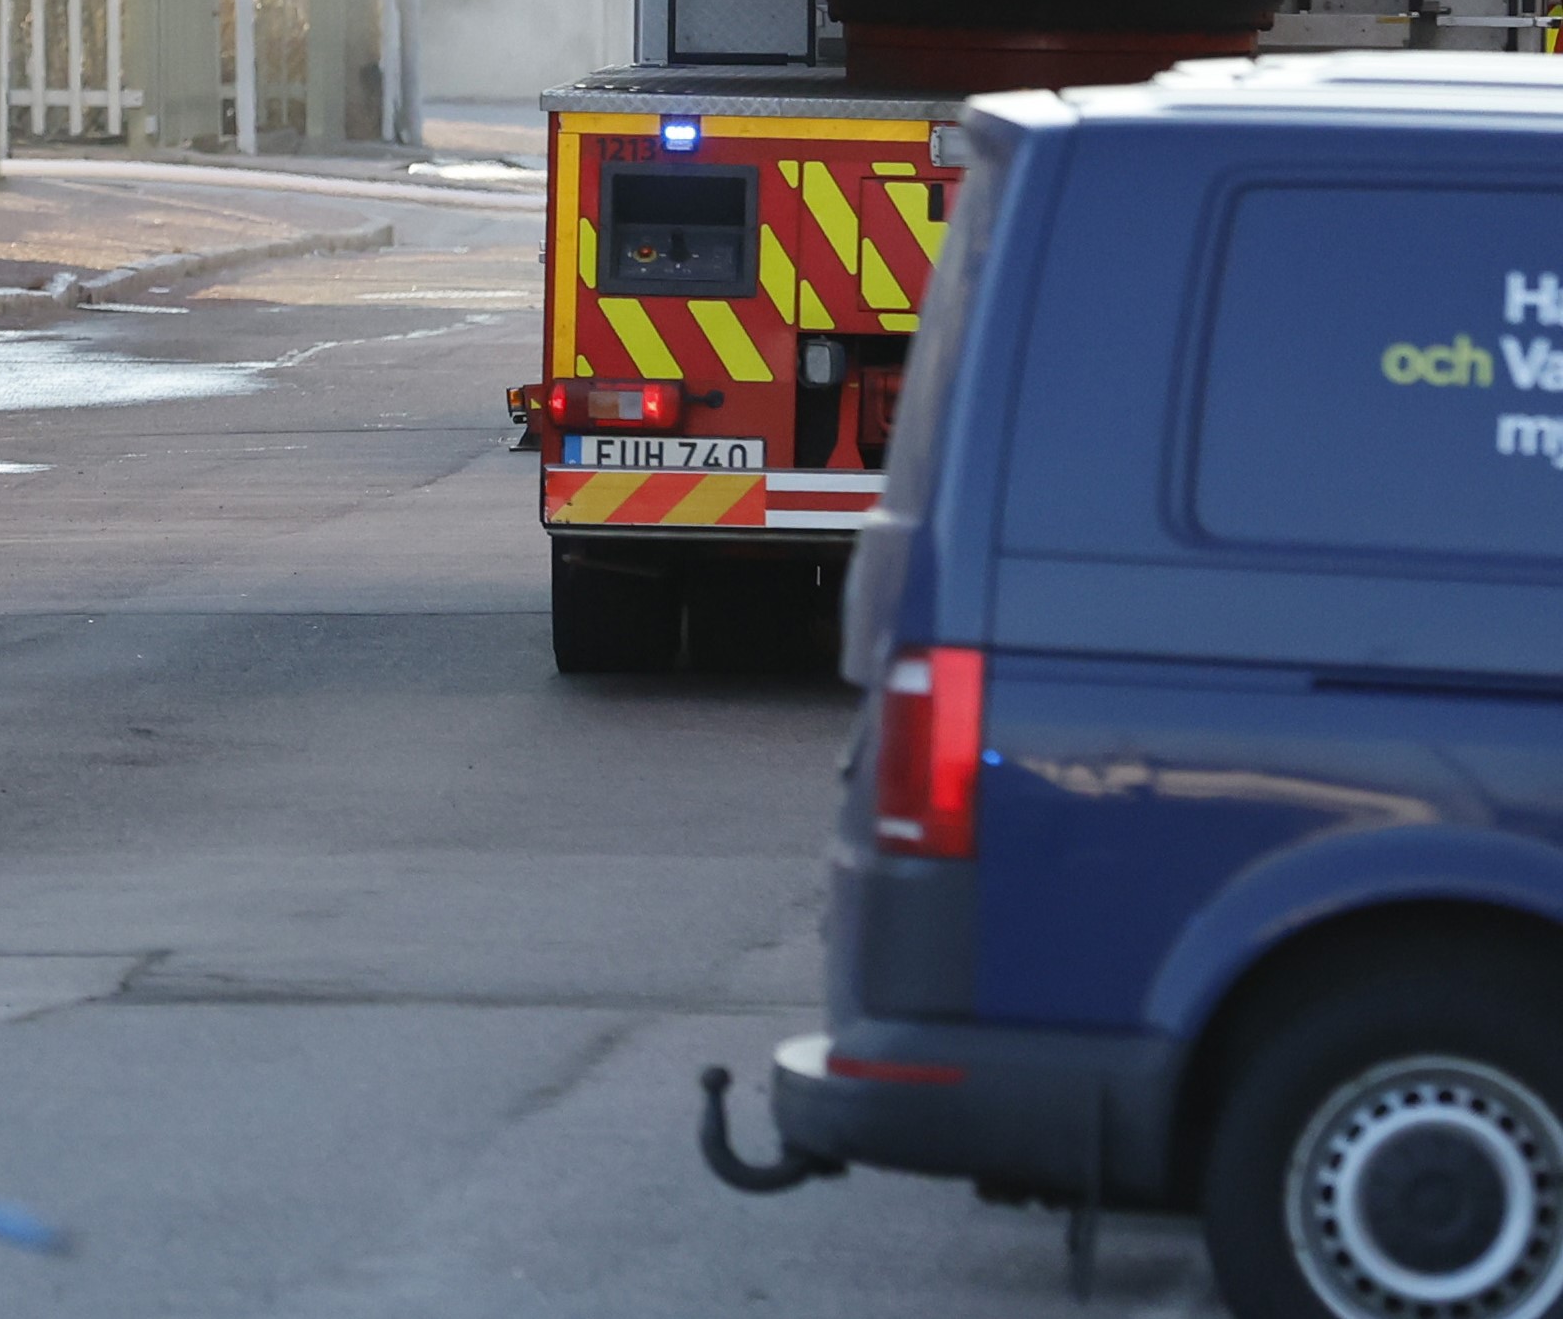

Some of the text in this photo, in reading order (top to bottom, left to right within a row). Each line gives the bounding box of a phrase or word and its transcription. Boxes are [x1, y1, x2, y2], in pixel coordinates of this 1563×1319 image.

[597, 137, 656, 162] 1213
[1504, 269, 1563, 327] H
[1381, 333, 1495, 388] och
[678, 442, 748, 469] 740
